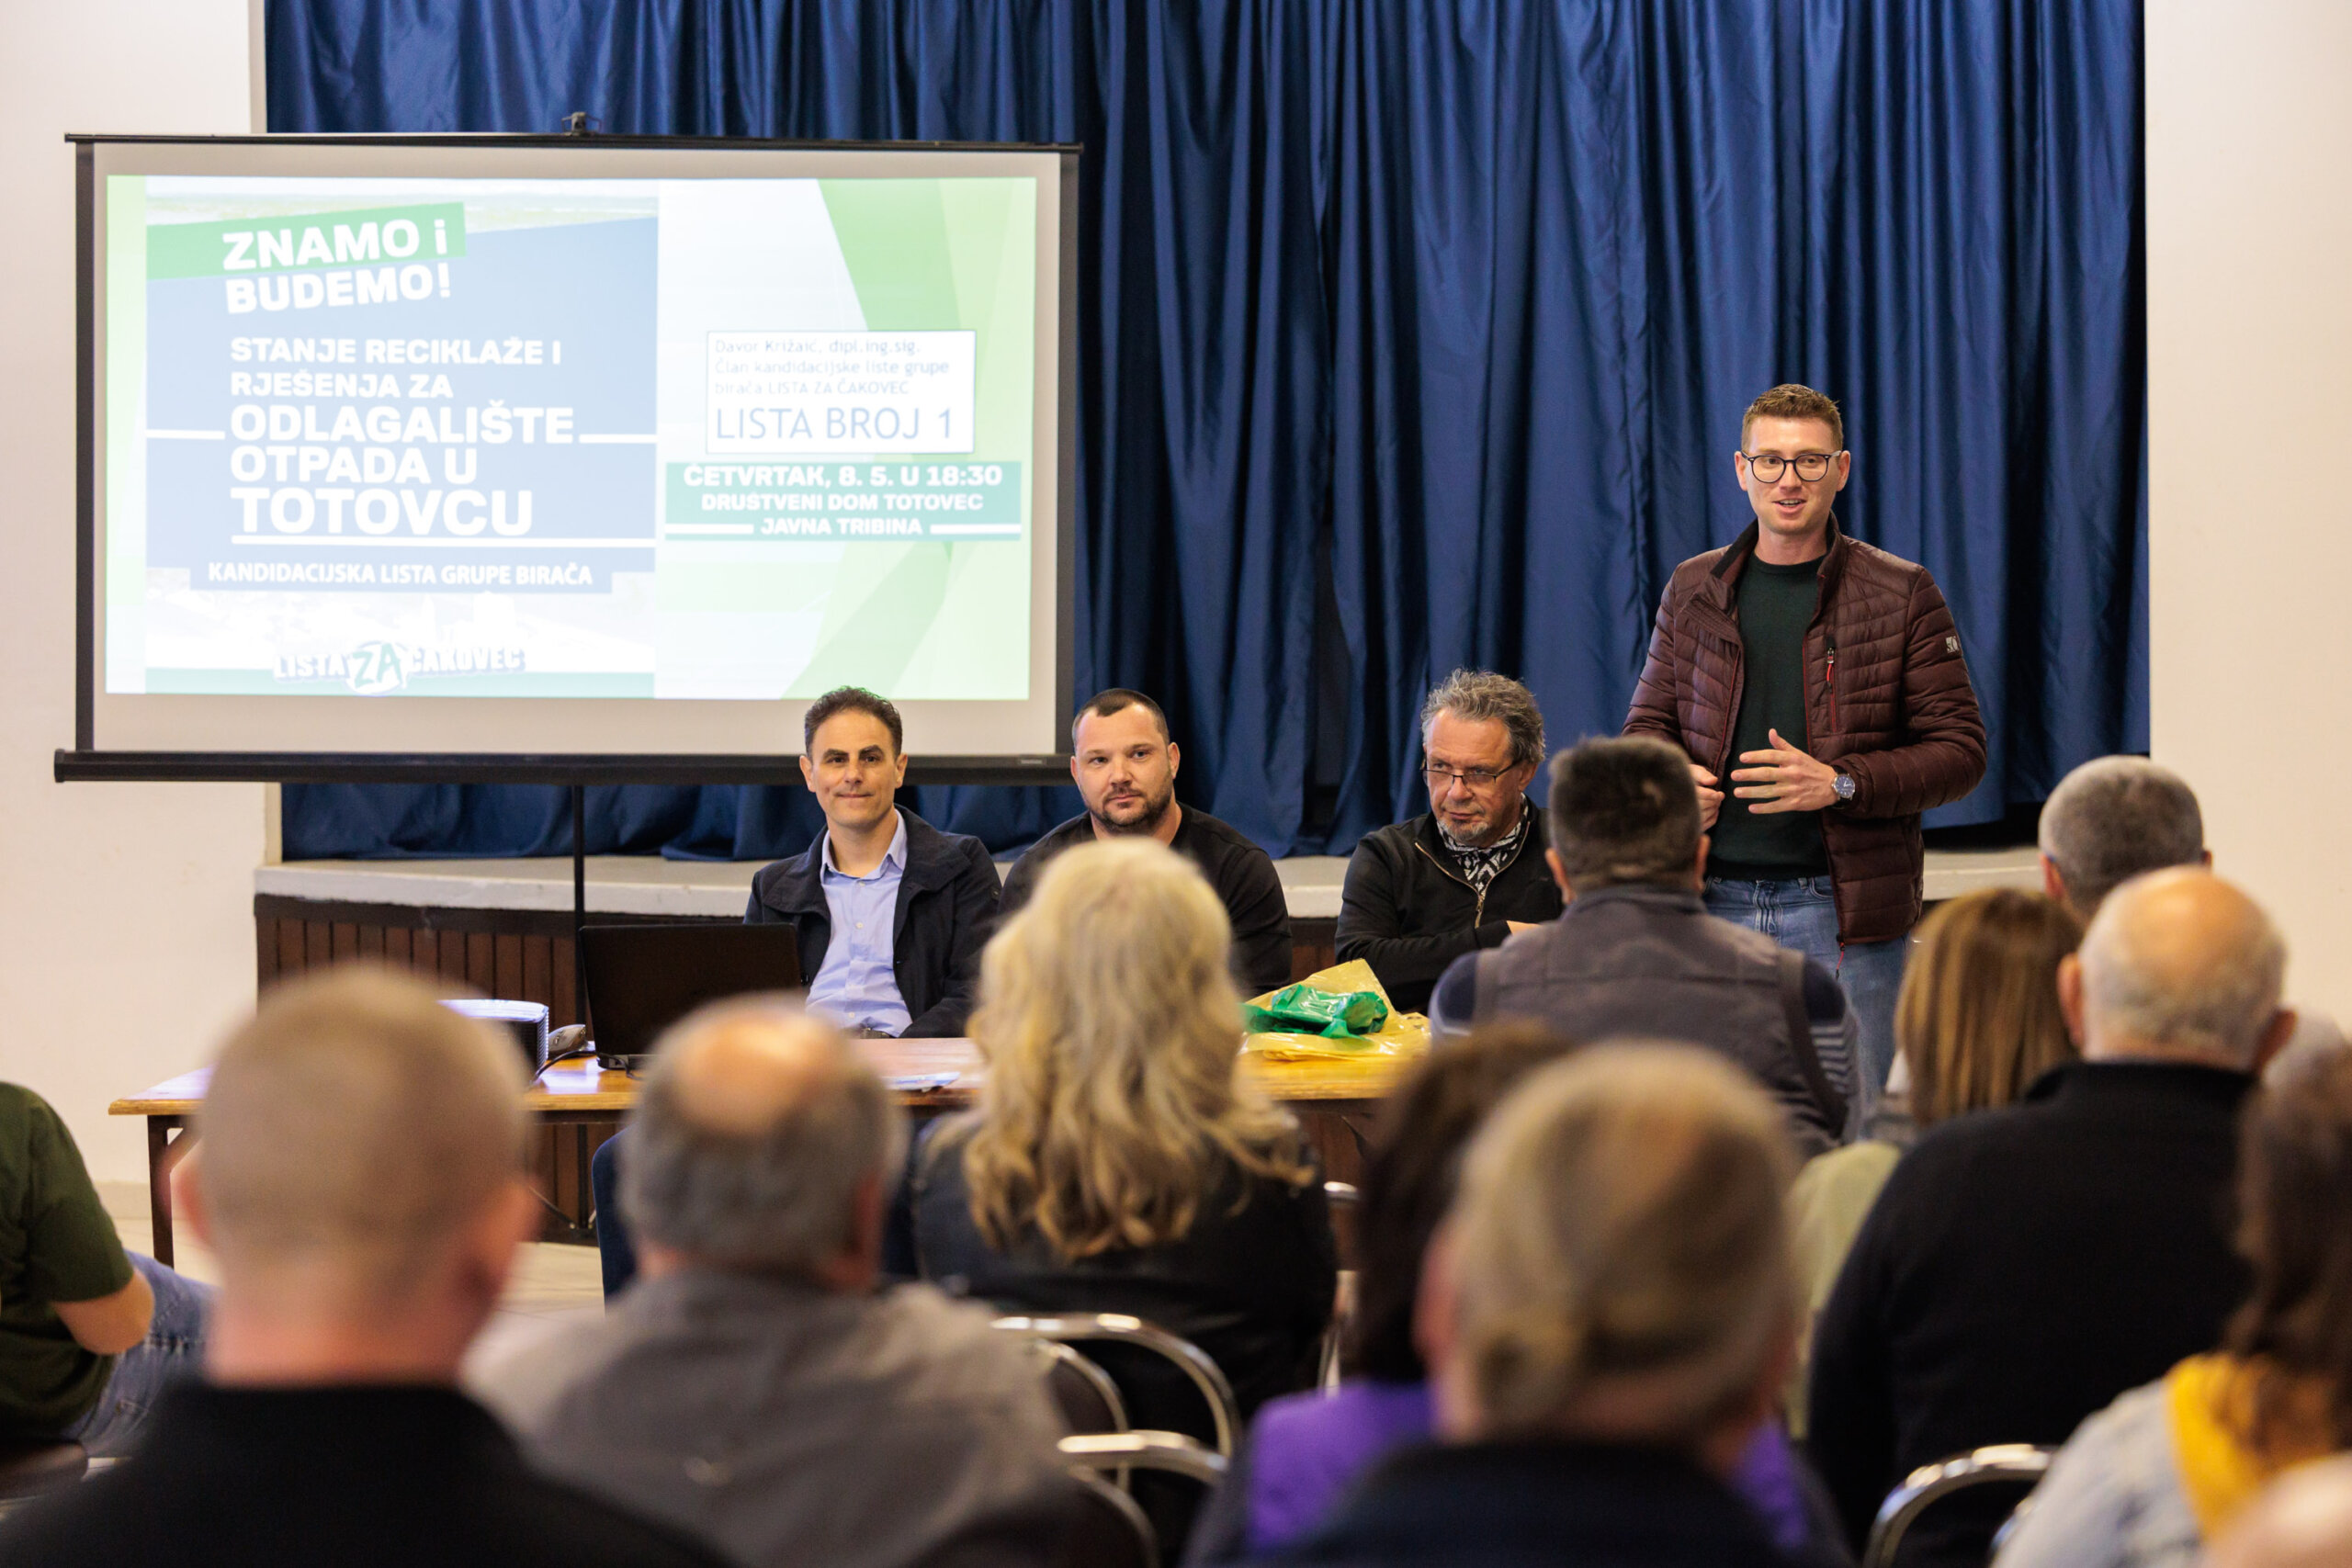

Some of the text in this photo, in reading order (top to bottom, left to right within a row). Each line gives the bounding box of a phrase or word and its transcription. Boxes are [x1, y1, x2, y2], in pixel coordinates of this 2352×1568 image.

[221, 219, 447, 271] ZNAMO i
[226, 263, 451, 314] BUDEMO!
[231, 334, 561, 365] STANJE RECIKLAŽE I
[716, 340, 759, 353] Davor
[716, 357, 949, 377] Član kandidacijske liste grupe
[231, 369, 453, 399] RJEŠENJA ZA
[716, 378, 910, 395] birača LISTA ZA ČAKOVEC
[231, 400, 573, 445] ODLAGALIŠTE
[717, 407, 952, 439] LISTA BROJ 1
[231, 446, 477, 485] OTPADA U
[684, 463, 1003, 489] ČETVRTAK, 8. 5. U 18:30
[230, 487, 533, 536] TOTOVCU
[702, 491, 984, 512] DRUŠTVENI DOM TOTOVEC
[761, 517, 922, 536] JAVNA TRIBINA
[209, 561, 593, 586] KANDIDACIJSKA LISTA GRUPE BIRAČA
[275, 654, 349, 679] LISTA
[352, 642, 402, 689] ZA
